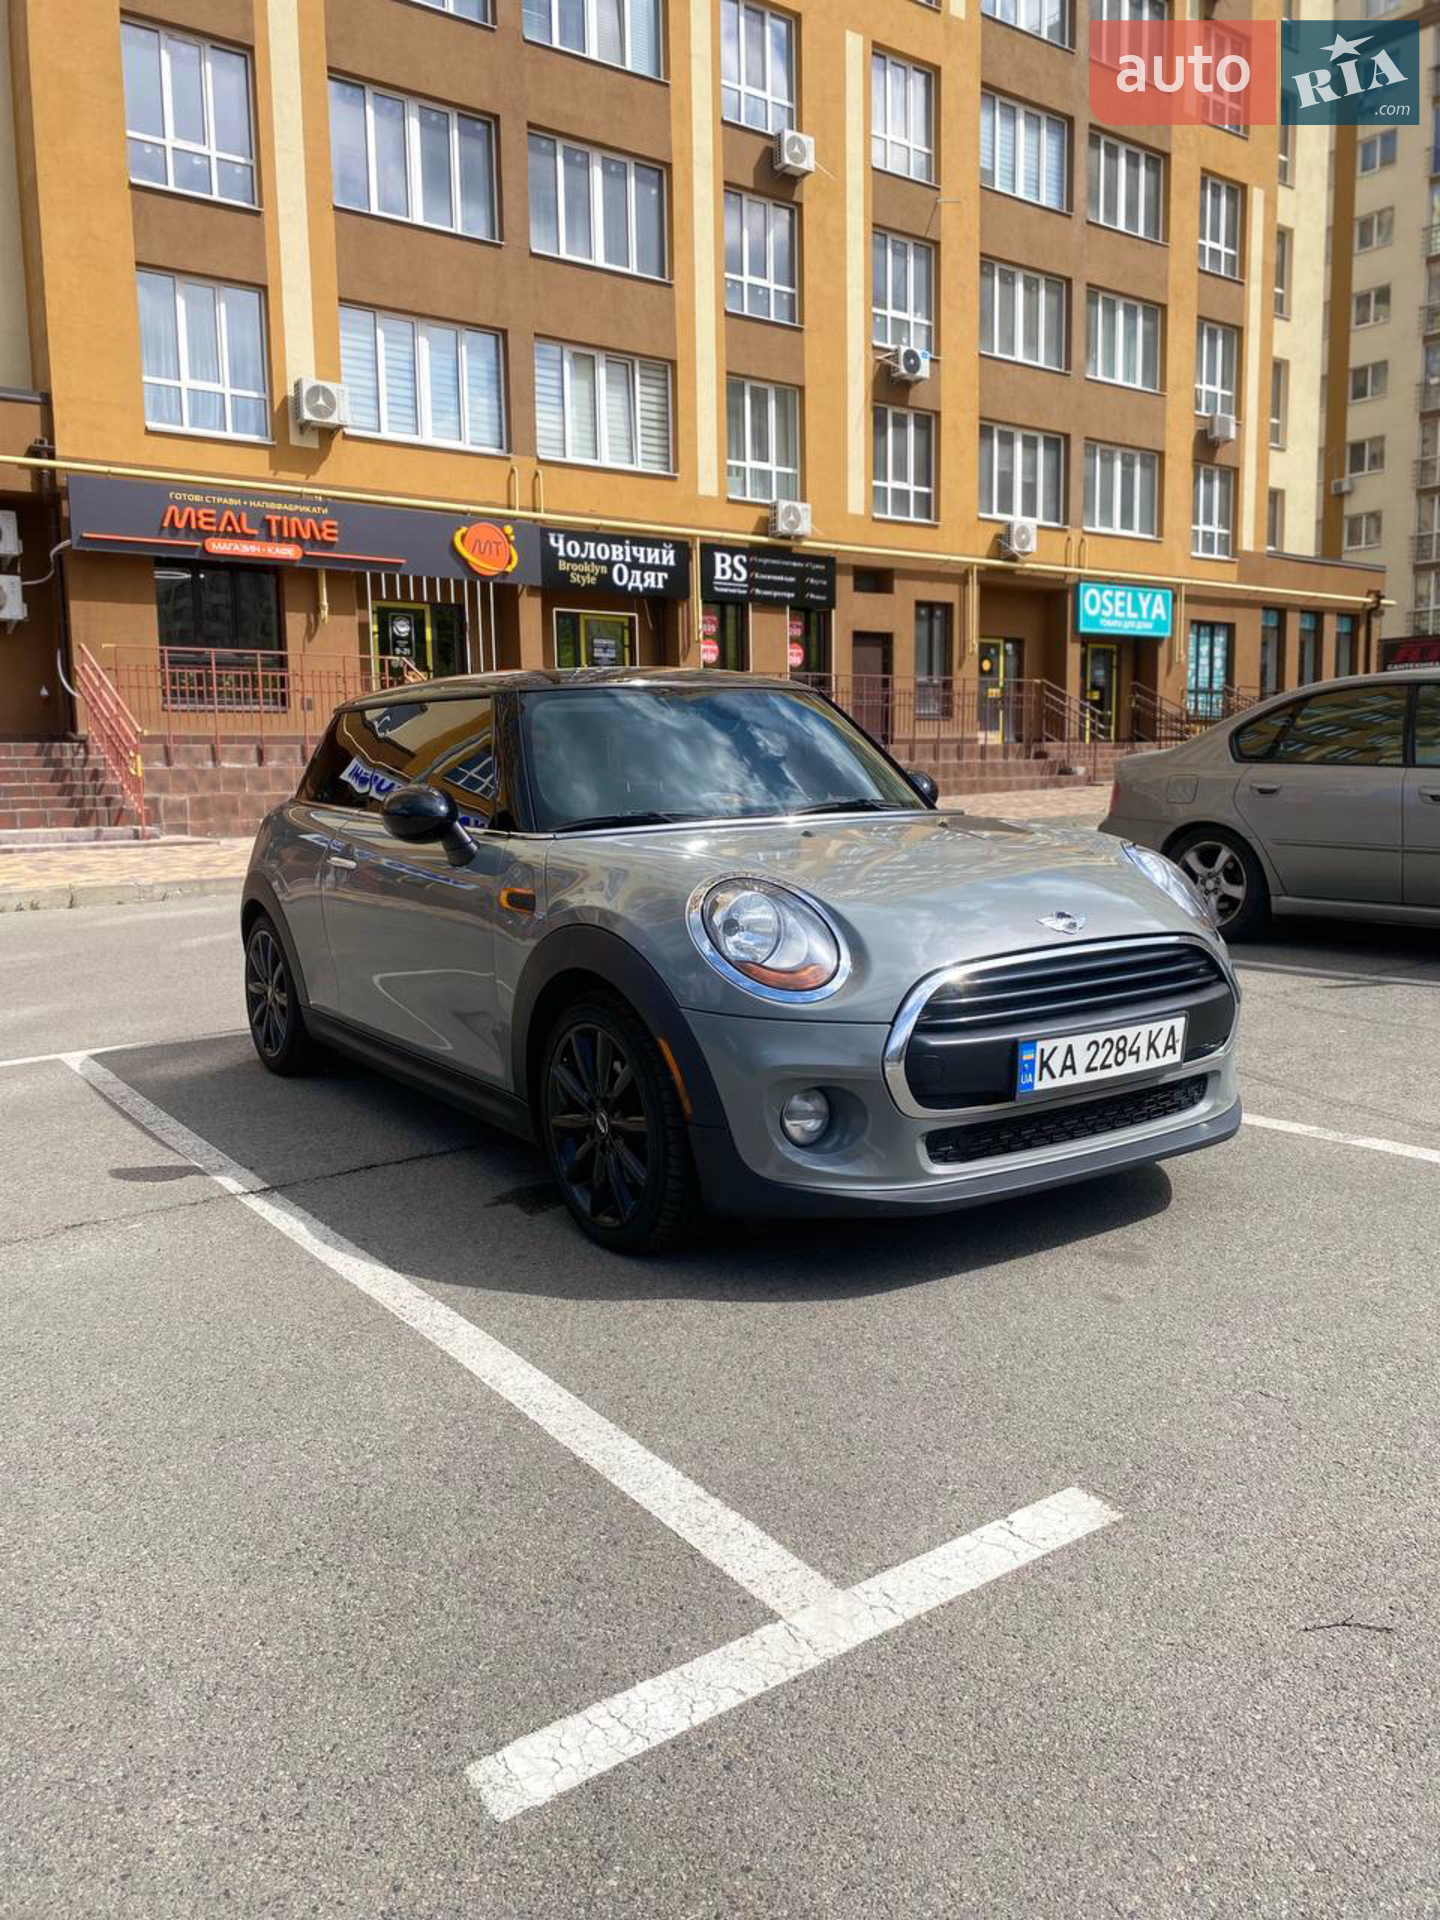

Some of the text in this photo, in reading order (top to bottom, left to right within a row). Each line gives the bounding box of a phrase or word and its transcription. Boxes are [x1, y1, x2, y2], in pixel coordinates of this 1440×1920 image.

[168, 492, 204, 502] ГОТОВІ
[205, 496, 241, 506] СТРАВИ
[162, 504, 339, 542] MEAL TIME
[212, 542, 294, 556] МАГАЗИН КАФЕ
[547, 532, 676, 566] Чоловічий
[558, 559, 608, 575] Brooklyn
[569, 572, 597, 587] Style
[612, 563, 669, 593] Одяг
[713, 551, 748, 582] BS
[1084, 587, 1167, 620] OSELYA
[1037, 1025, 1177, 1082] KA 2284 KA
[1020, 1073, 1033, 1084] UA
